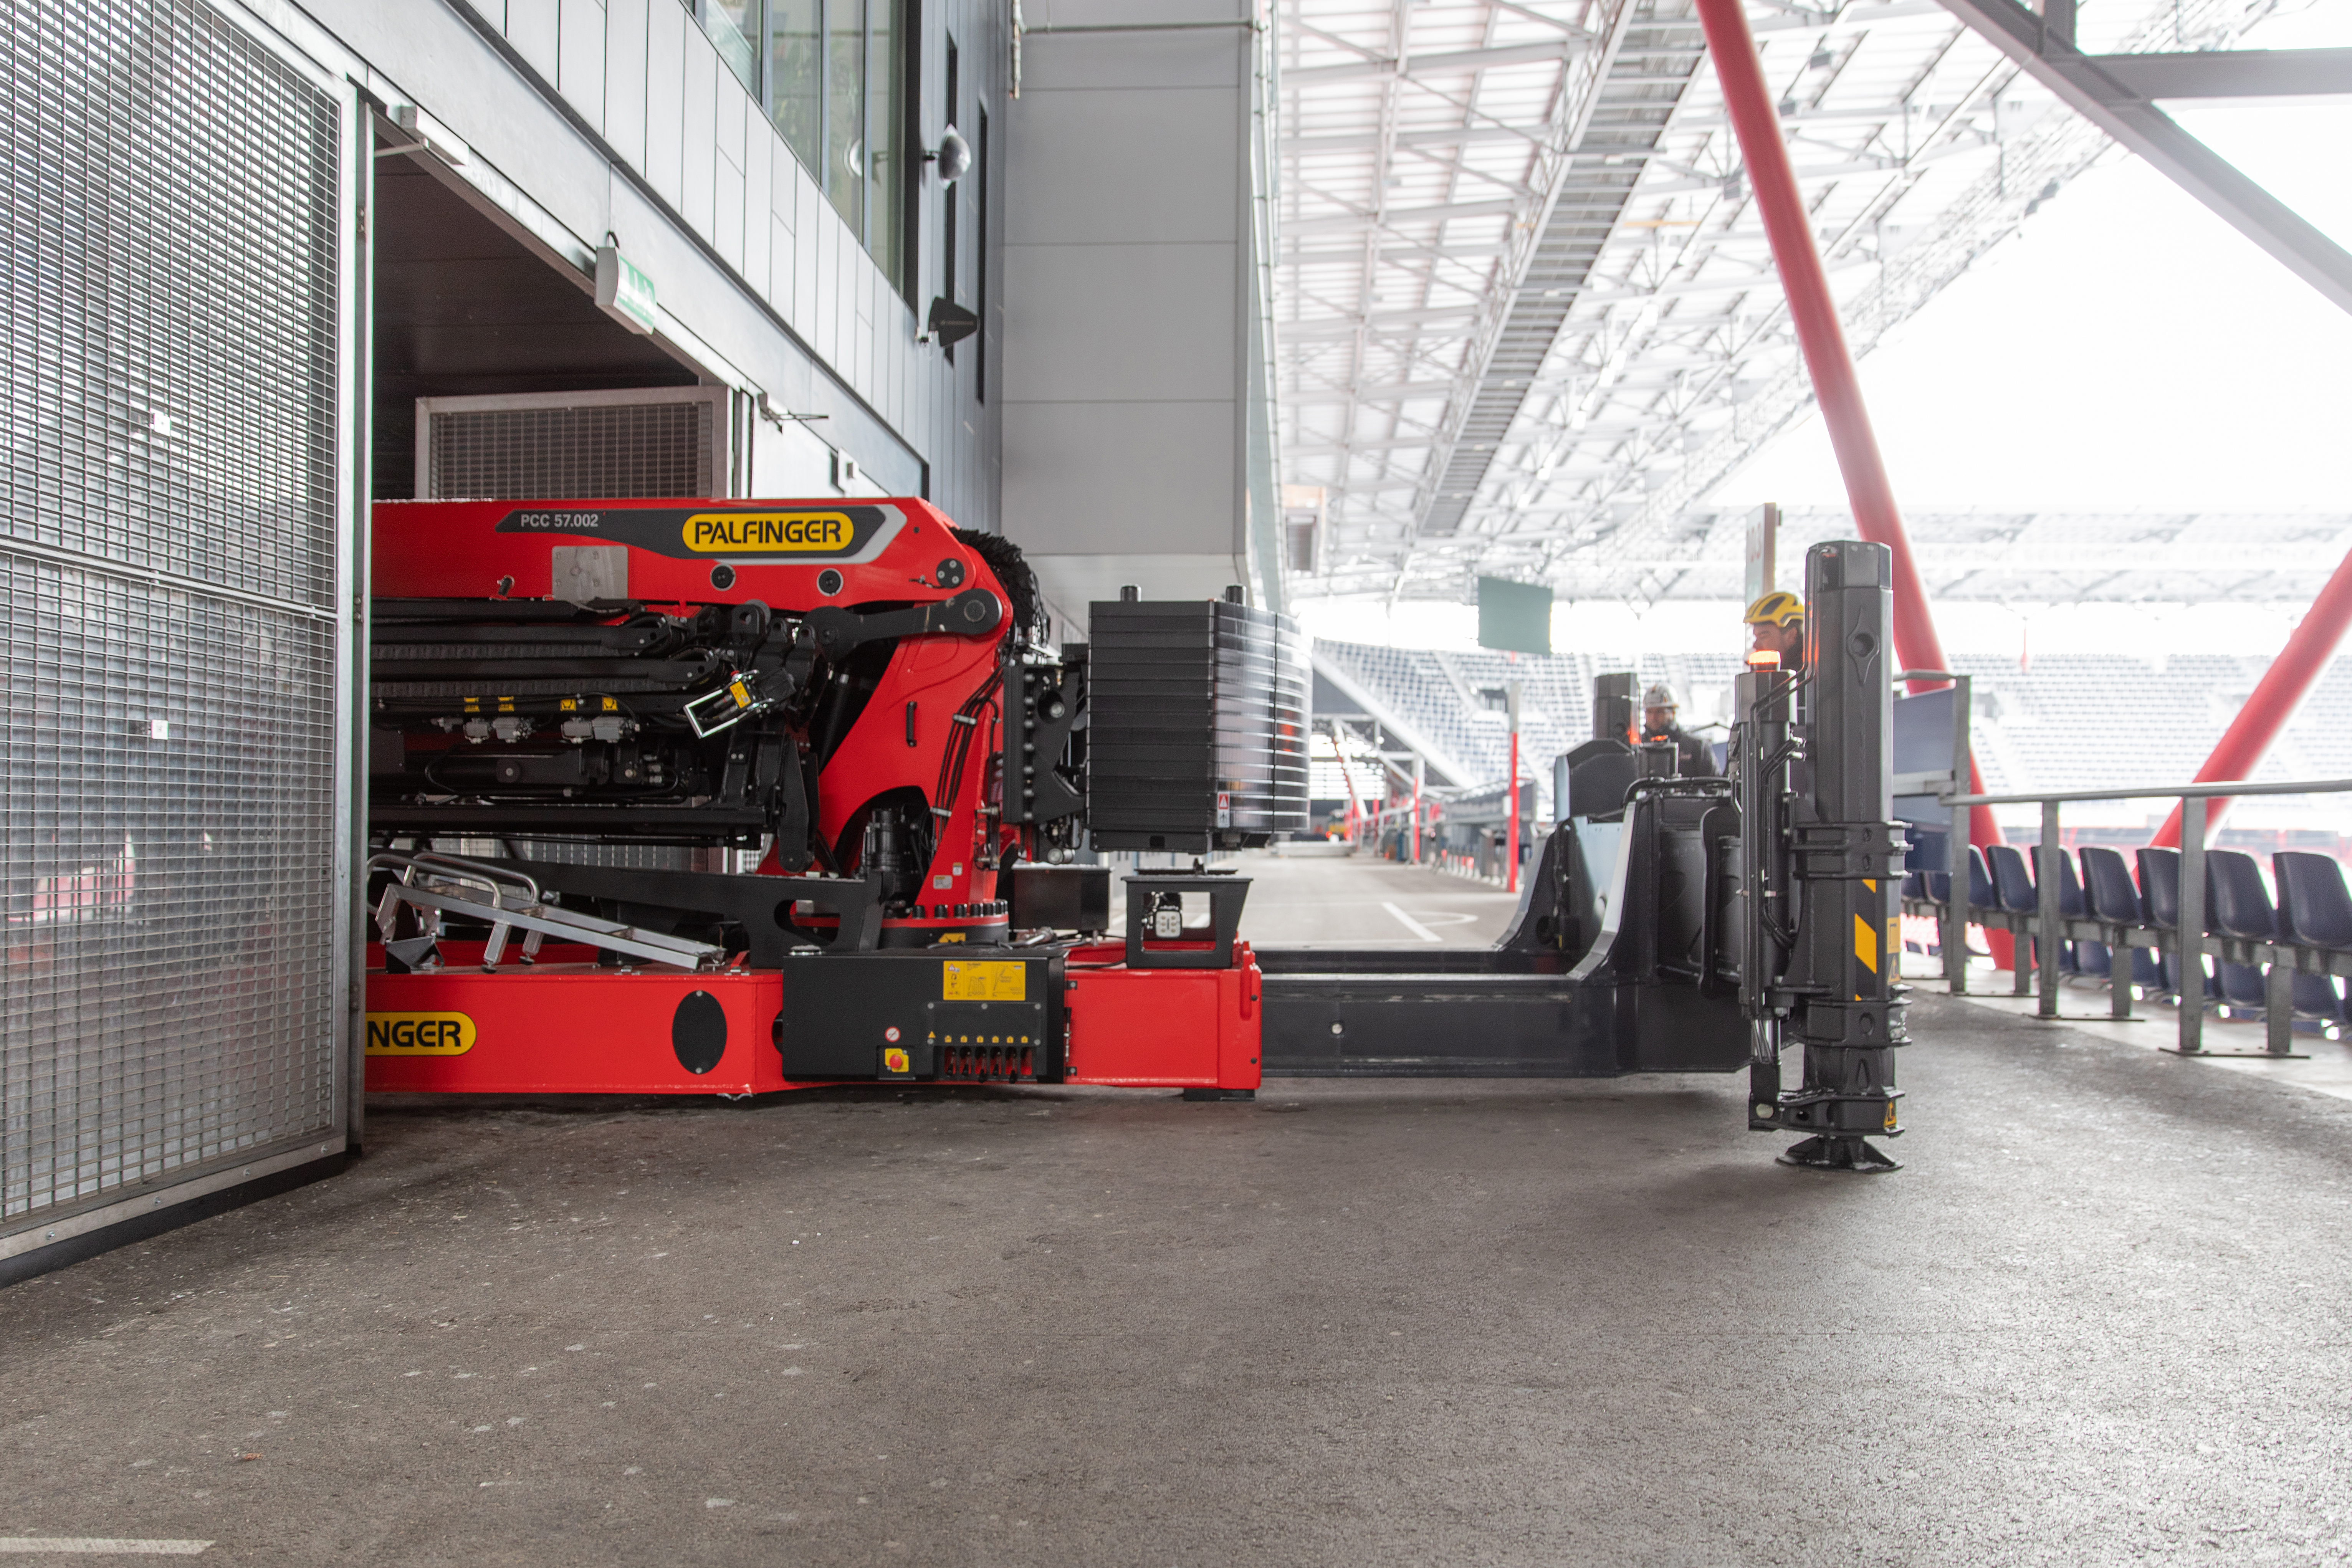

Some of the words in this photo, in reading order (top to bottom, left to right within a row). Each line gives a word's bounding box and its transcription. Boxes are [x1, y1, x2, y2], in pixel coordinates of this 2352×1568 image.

[522, 514, 549, 527] PCC
[555, 514, 598, 527] 57.002
[695, 520, 840, 543] PALFINGER
